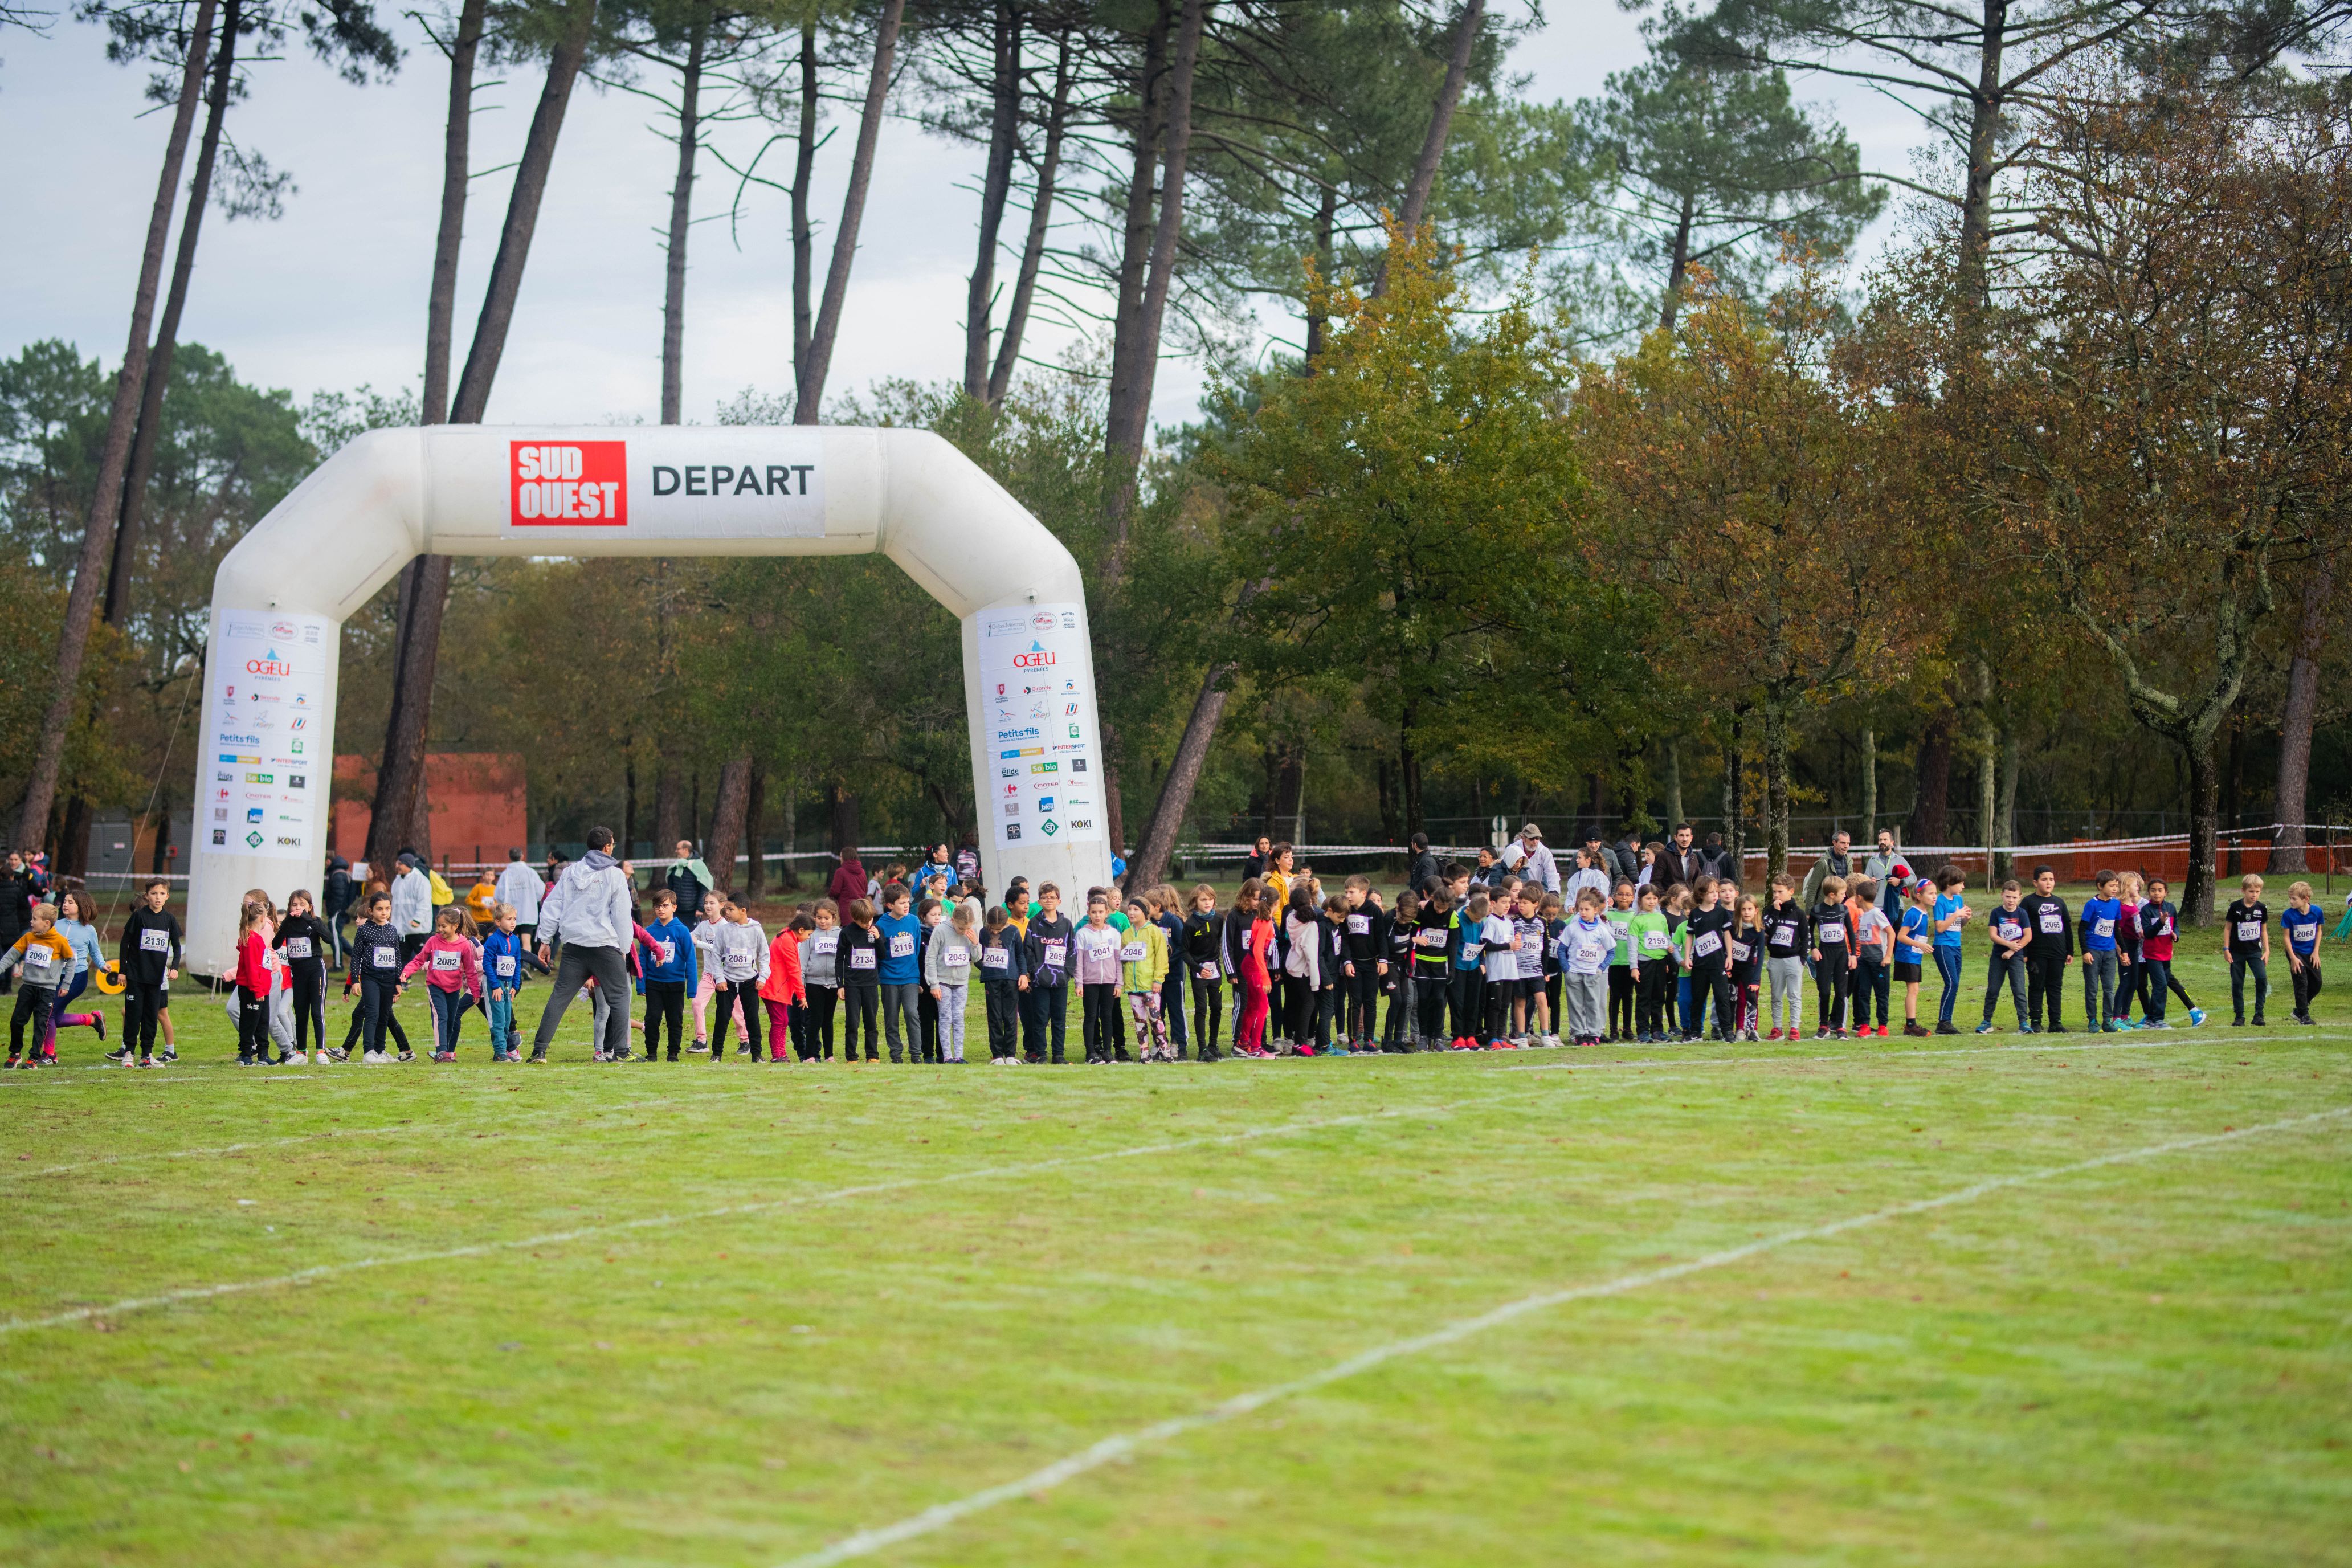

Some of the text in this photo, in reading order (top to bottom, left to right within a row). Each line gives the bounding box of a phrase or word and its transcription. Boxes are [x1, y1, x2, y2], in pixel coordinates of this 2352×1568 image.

[518, 446, 582, 480] SUD
[653, 465, 815, 496] DEPART
[519, 481, 619, 519] OUEST
[1013, 651, 1056, 668] OGEU
[246, 659, 291, 676] OGEU
[998, 727, 1039, 739] Petits-fils
[1071, 819, 1092, 828] KOKI
[277, 837, 301, 846] KOKI
[2002, 928, 2017, 938] 2067
[145, 937, 165, 946] 2136
[894, 942, 912, 952] 2116
[1698, 938, 1717, 951] 2074
[29, 951, 47, 962] 2090
[1092, 946, 1110, 957] 2041
[1732, 948, 1745, 957] 069
[437, 957, 457, 966] 2082
[986, 954, 1004, 963] 2044
